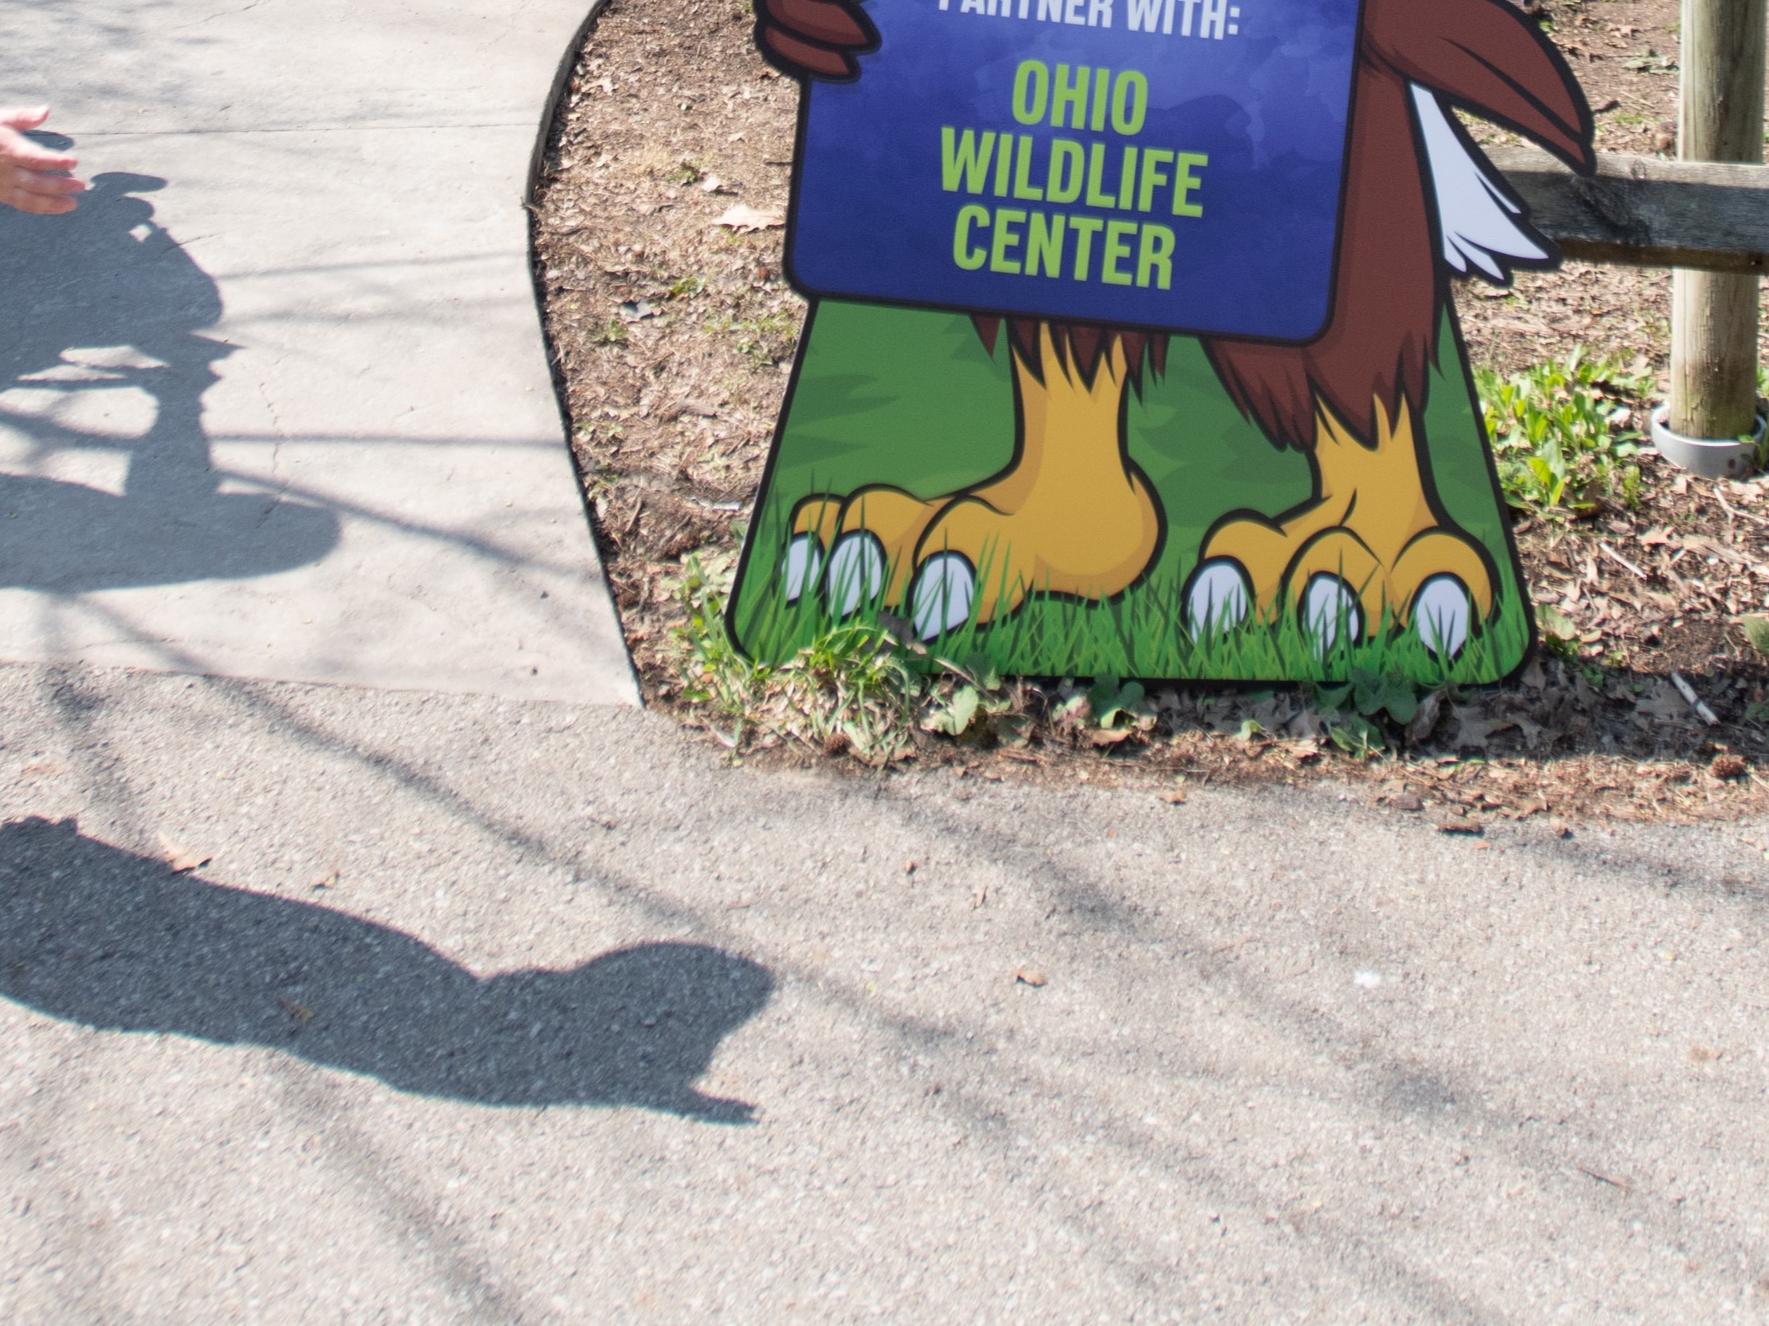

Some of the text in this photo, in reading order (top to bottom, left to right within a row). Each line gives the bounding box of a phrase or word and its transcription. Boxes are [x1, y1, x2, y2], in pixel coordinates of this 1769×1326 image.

[1012, 59, 1148, 136] OHIO
[941, 126, 1209, 218] WILDLIFE
[953, 204, 1176, 290] CENTER
